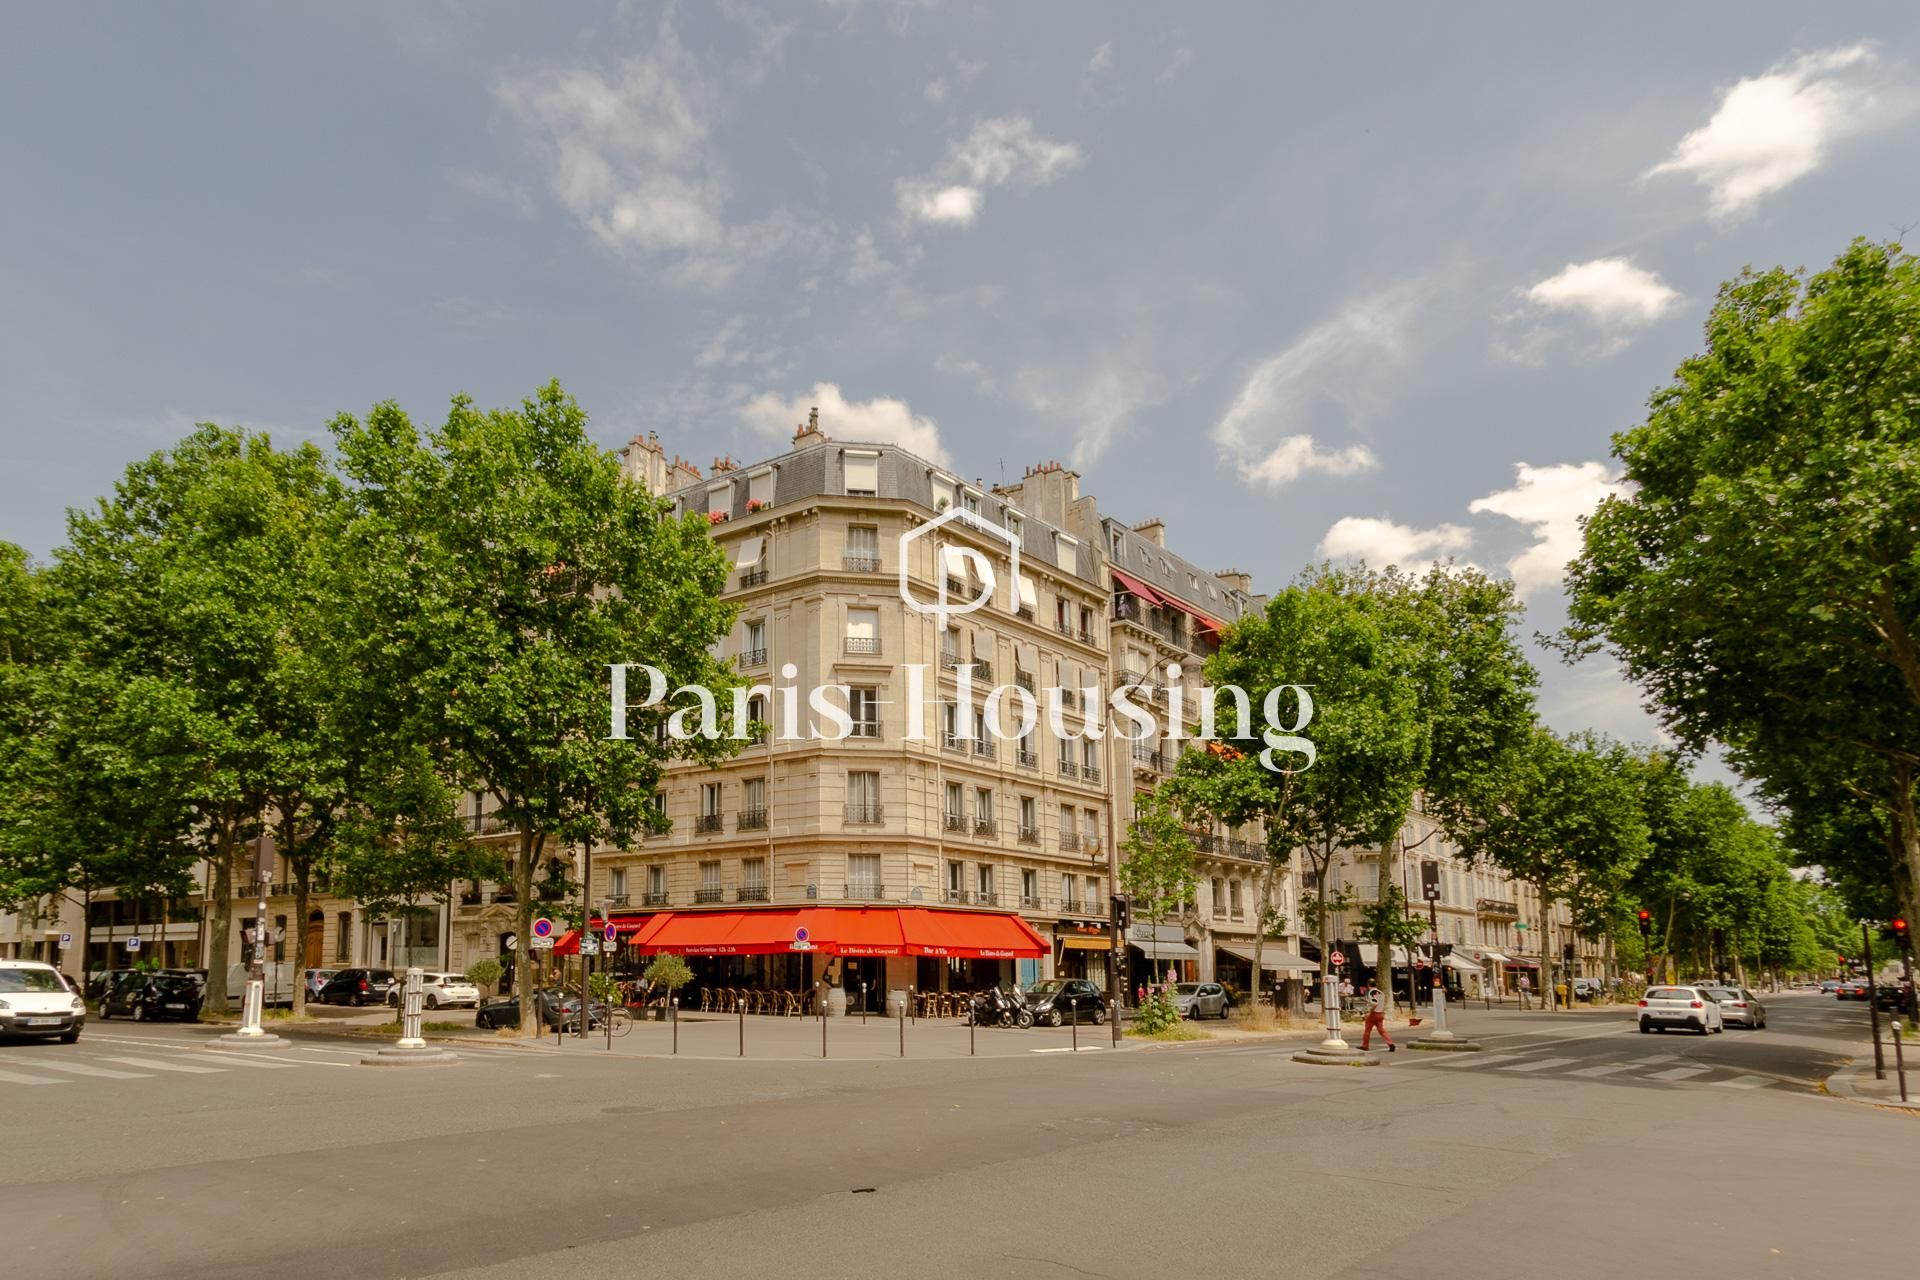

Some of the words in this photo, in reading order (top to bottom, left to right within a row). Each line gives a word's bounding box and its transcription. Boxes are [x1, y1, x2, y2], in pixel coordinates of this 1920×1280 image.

[874, 947, 898, 955] Gaspard
[923, 946, 934, 954] Bar
[939, 947, 948, 955] Vin
